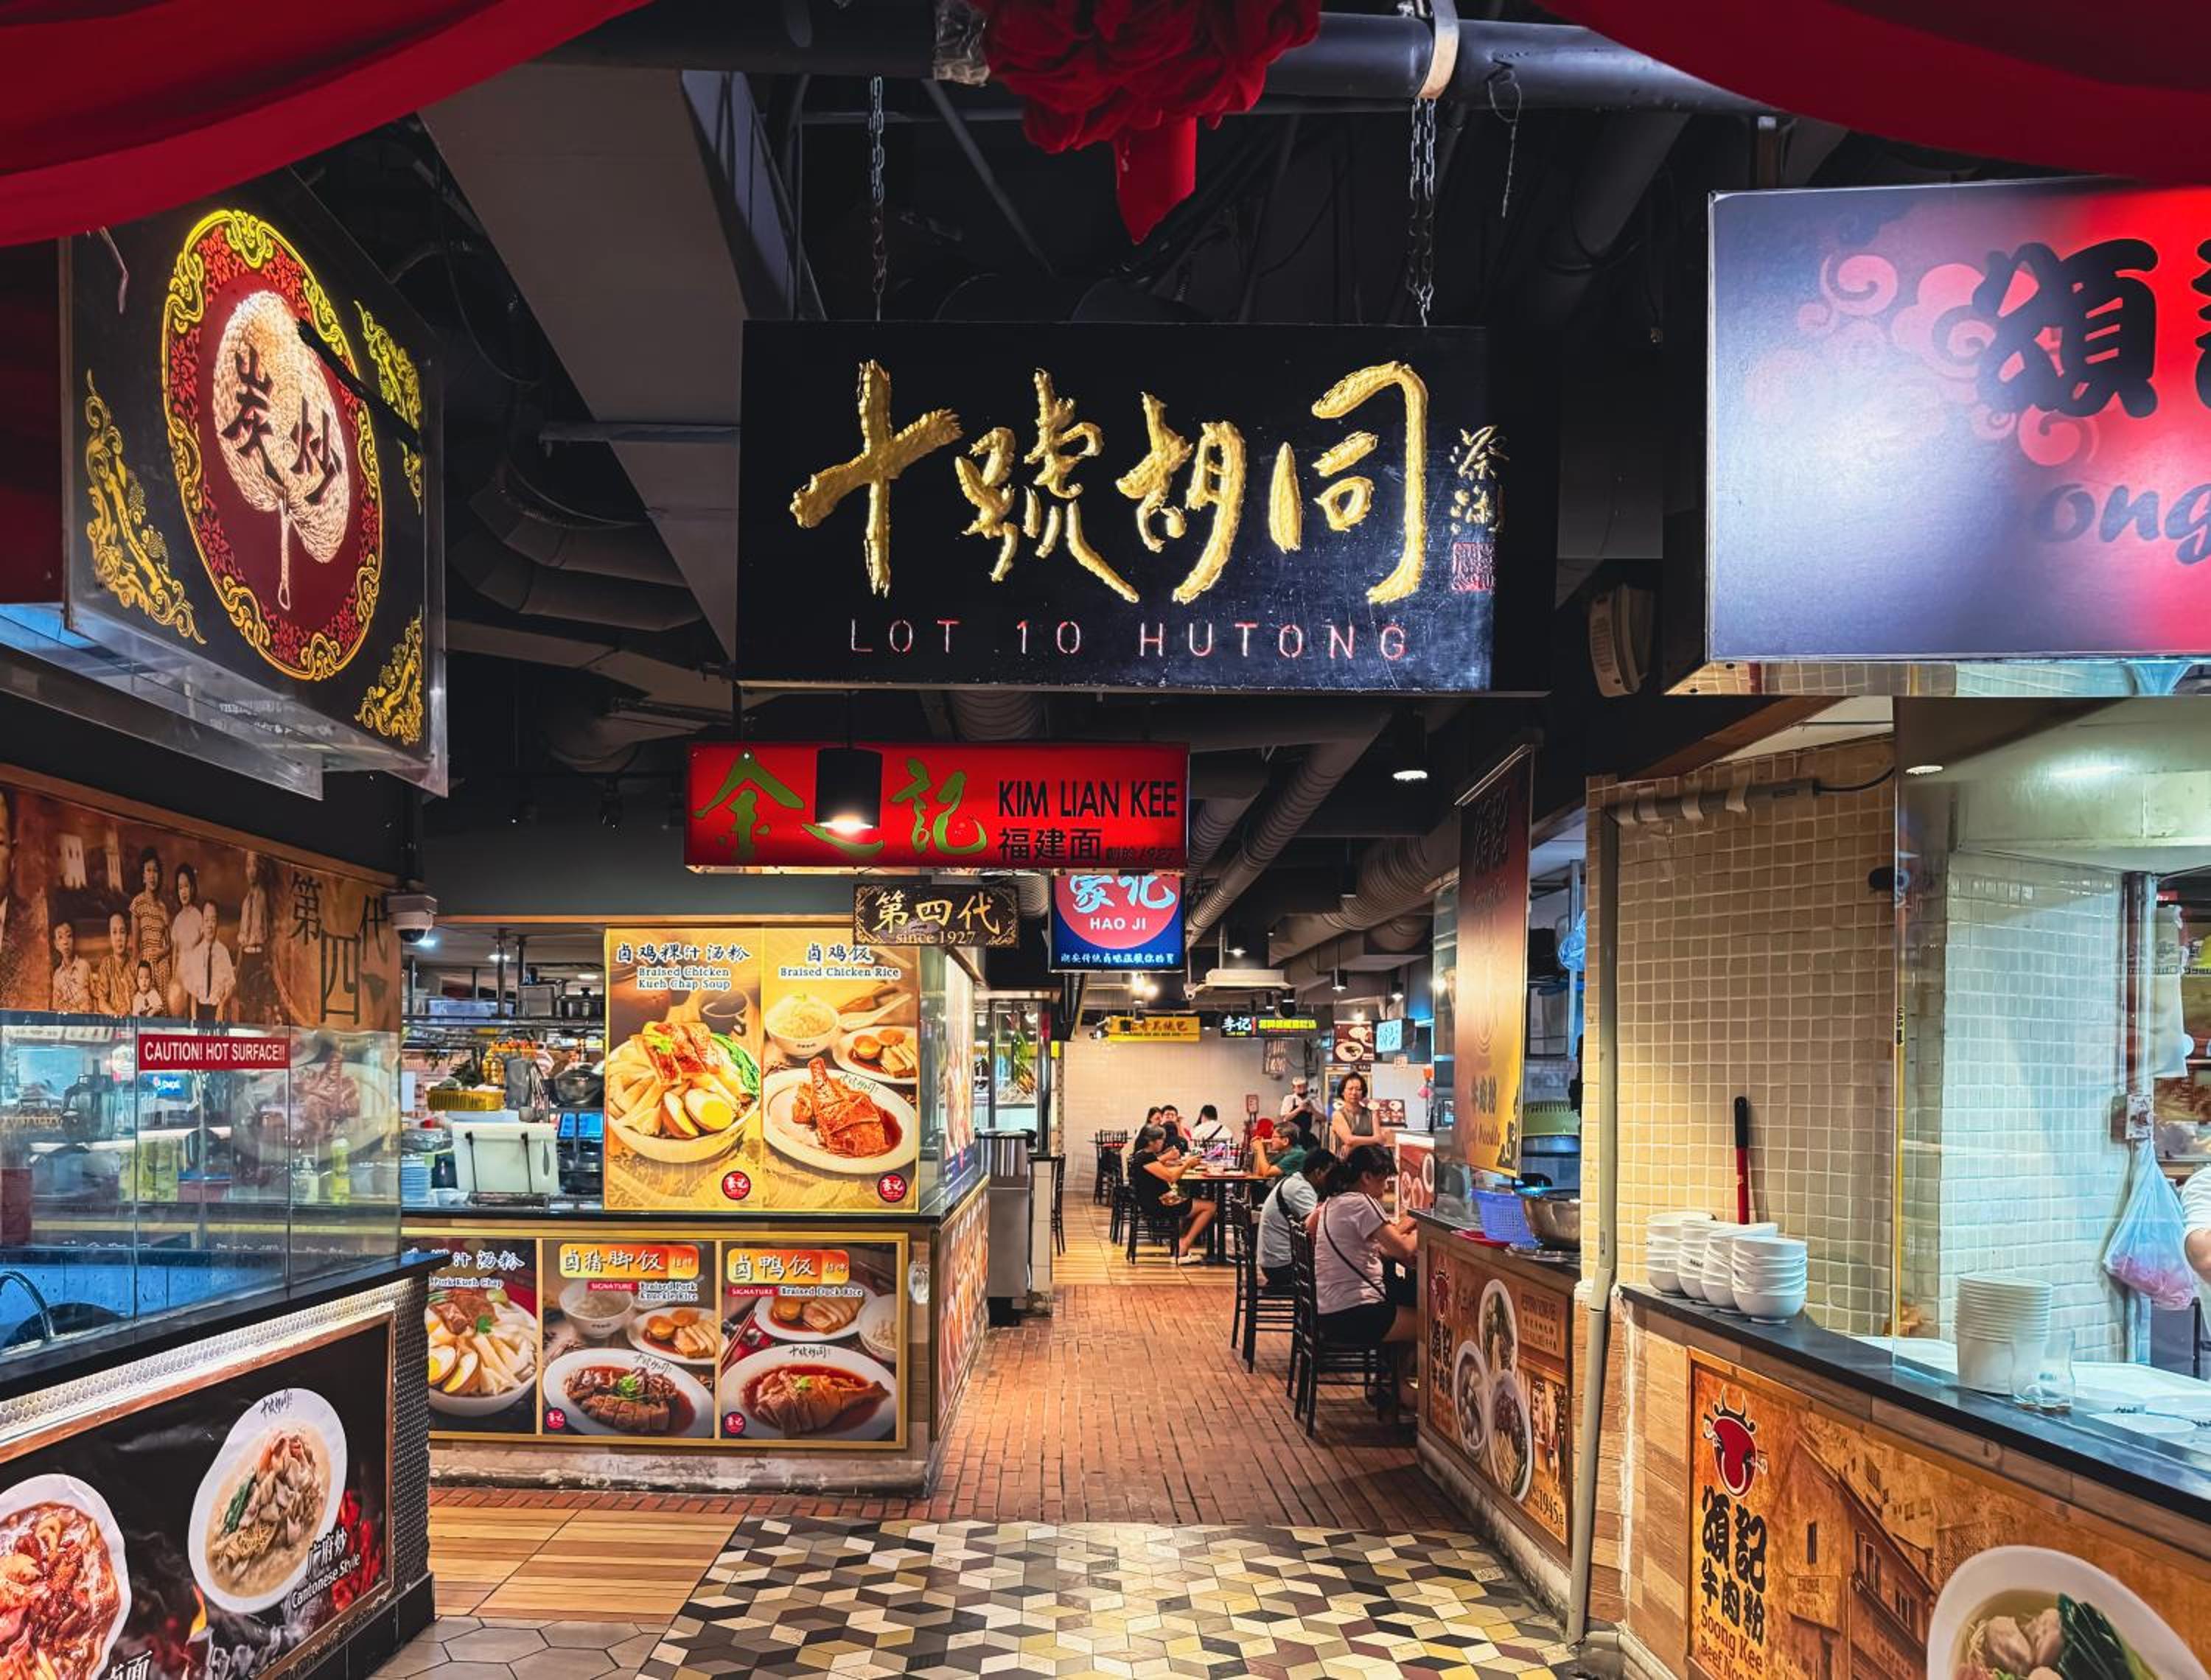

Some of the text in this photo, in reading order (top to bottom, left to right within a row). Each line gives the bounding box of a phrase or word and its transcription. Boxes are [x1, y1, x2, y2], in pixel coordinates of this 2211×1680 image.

[849, 620, 1410, 660] LOT 10 HUTONG
[998, 780, 1178, 818] KIM LIAN KEE
[998, 827, 1103, 861] 福建面
[872, 889, 1000, 935] 第四代
[1090, 917, 1146, 930] HAO JI
[895, 931, 975, 945] since 1927
[806, 943, 873, 963] 卤鸡饭
[639, 967, 729, 977] Braised Chicken
[780, 967, 899, 977] Braised Chicken Rice
[639, 979, 730, 990] Kueh Chap Soup
[144, 1041, 203, 1061] CAUTION!
[206, 1043, 229, 1061] HOT
[565, 1249, 666, 1273] 卤猪脚饭
[734, 1253, 817, 1281] 卤鸭饭
[676, 1281, 697, 1291] Pork
[292, 1553, 360, 1609] Cantonese Style
[1700, 1633, 1723, 1671] Beef
[1701, 1604, 1736, 1659] Soong
[1739, 1635, 1764, 1676] Kee
